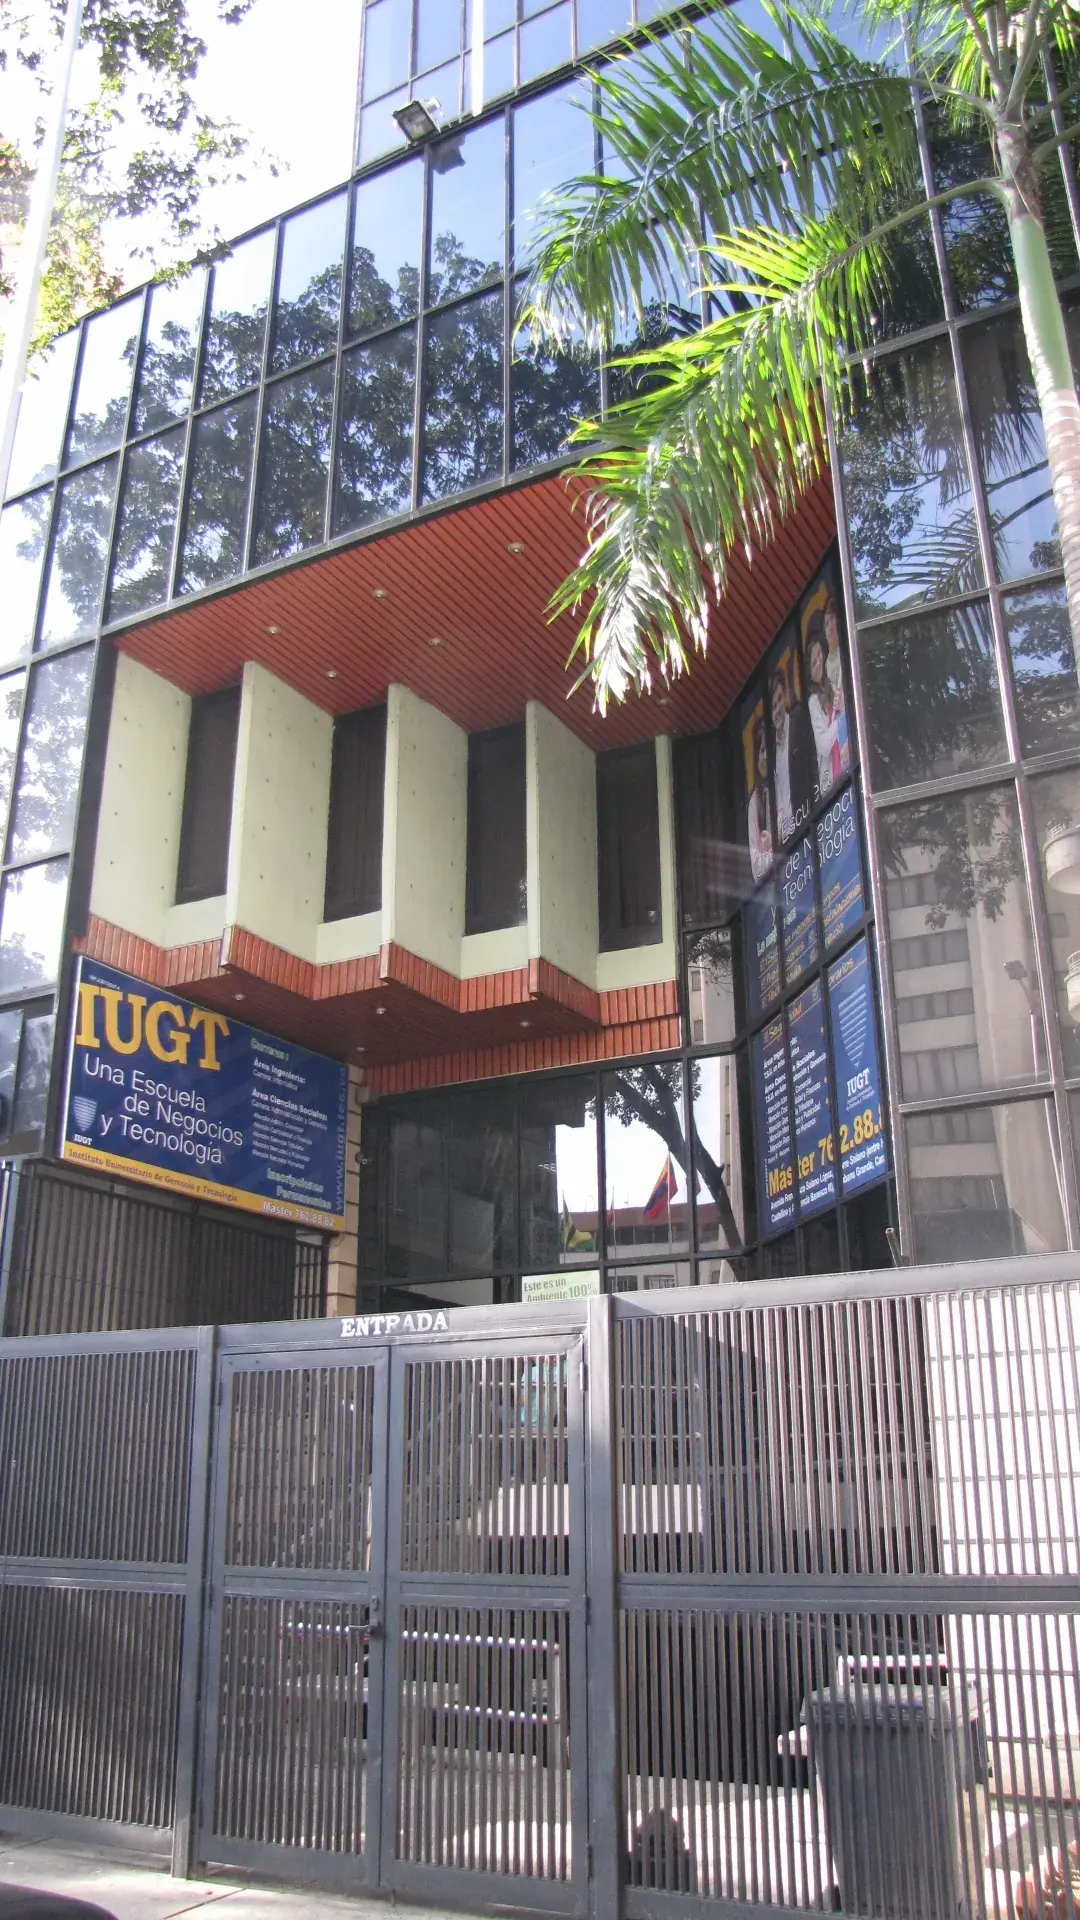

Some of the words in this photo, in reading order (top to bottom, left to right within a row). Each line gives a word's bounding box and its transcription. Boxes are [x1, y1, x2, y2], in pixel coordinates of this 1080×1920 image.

[784, 852, 800, 879] de
[76, 983, 230, 1071] IUGT
[84, 1053, 125, 1086] Una
[131, 1070, 206, 1113] Escuela
[847, 1067, 870, 1097] IUGT
[270, 1095, 299, 1111] Ciencias
[124, 1093, 150, 1116] de
[156, 1101, 244, 1146] Negocios
[74, 1134, 93, 1146] IUGT
[101, 1114, 114, 1136] y
[120, 1115, 223, 1165] Tecnología
[69, 1149, 104, 1166] Instituto
[105, 1157, 153, 1180] Universitario
[154, 1173, 163, 1181] de
[164, 1174, 195, 1190] Gerencia
[196, 1184, 202, 1192] y
[524, 1281, 542, 1292] Este
[543, 1279, 554, 1289] es
[555, 1278, 567, 1287] un
[527, 1289, 568, 1302] Ambiente
